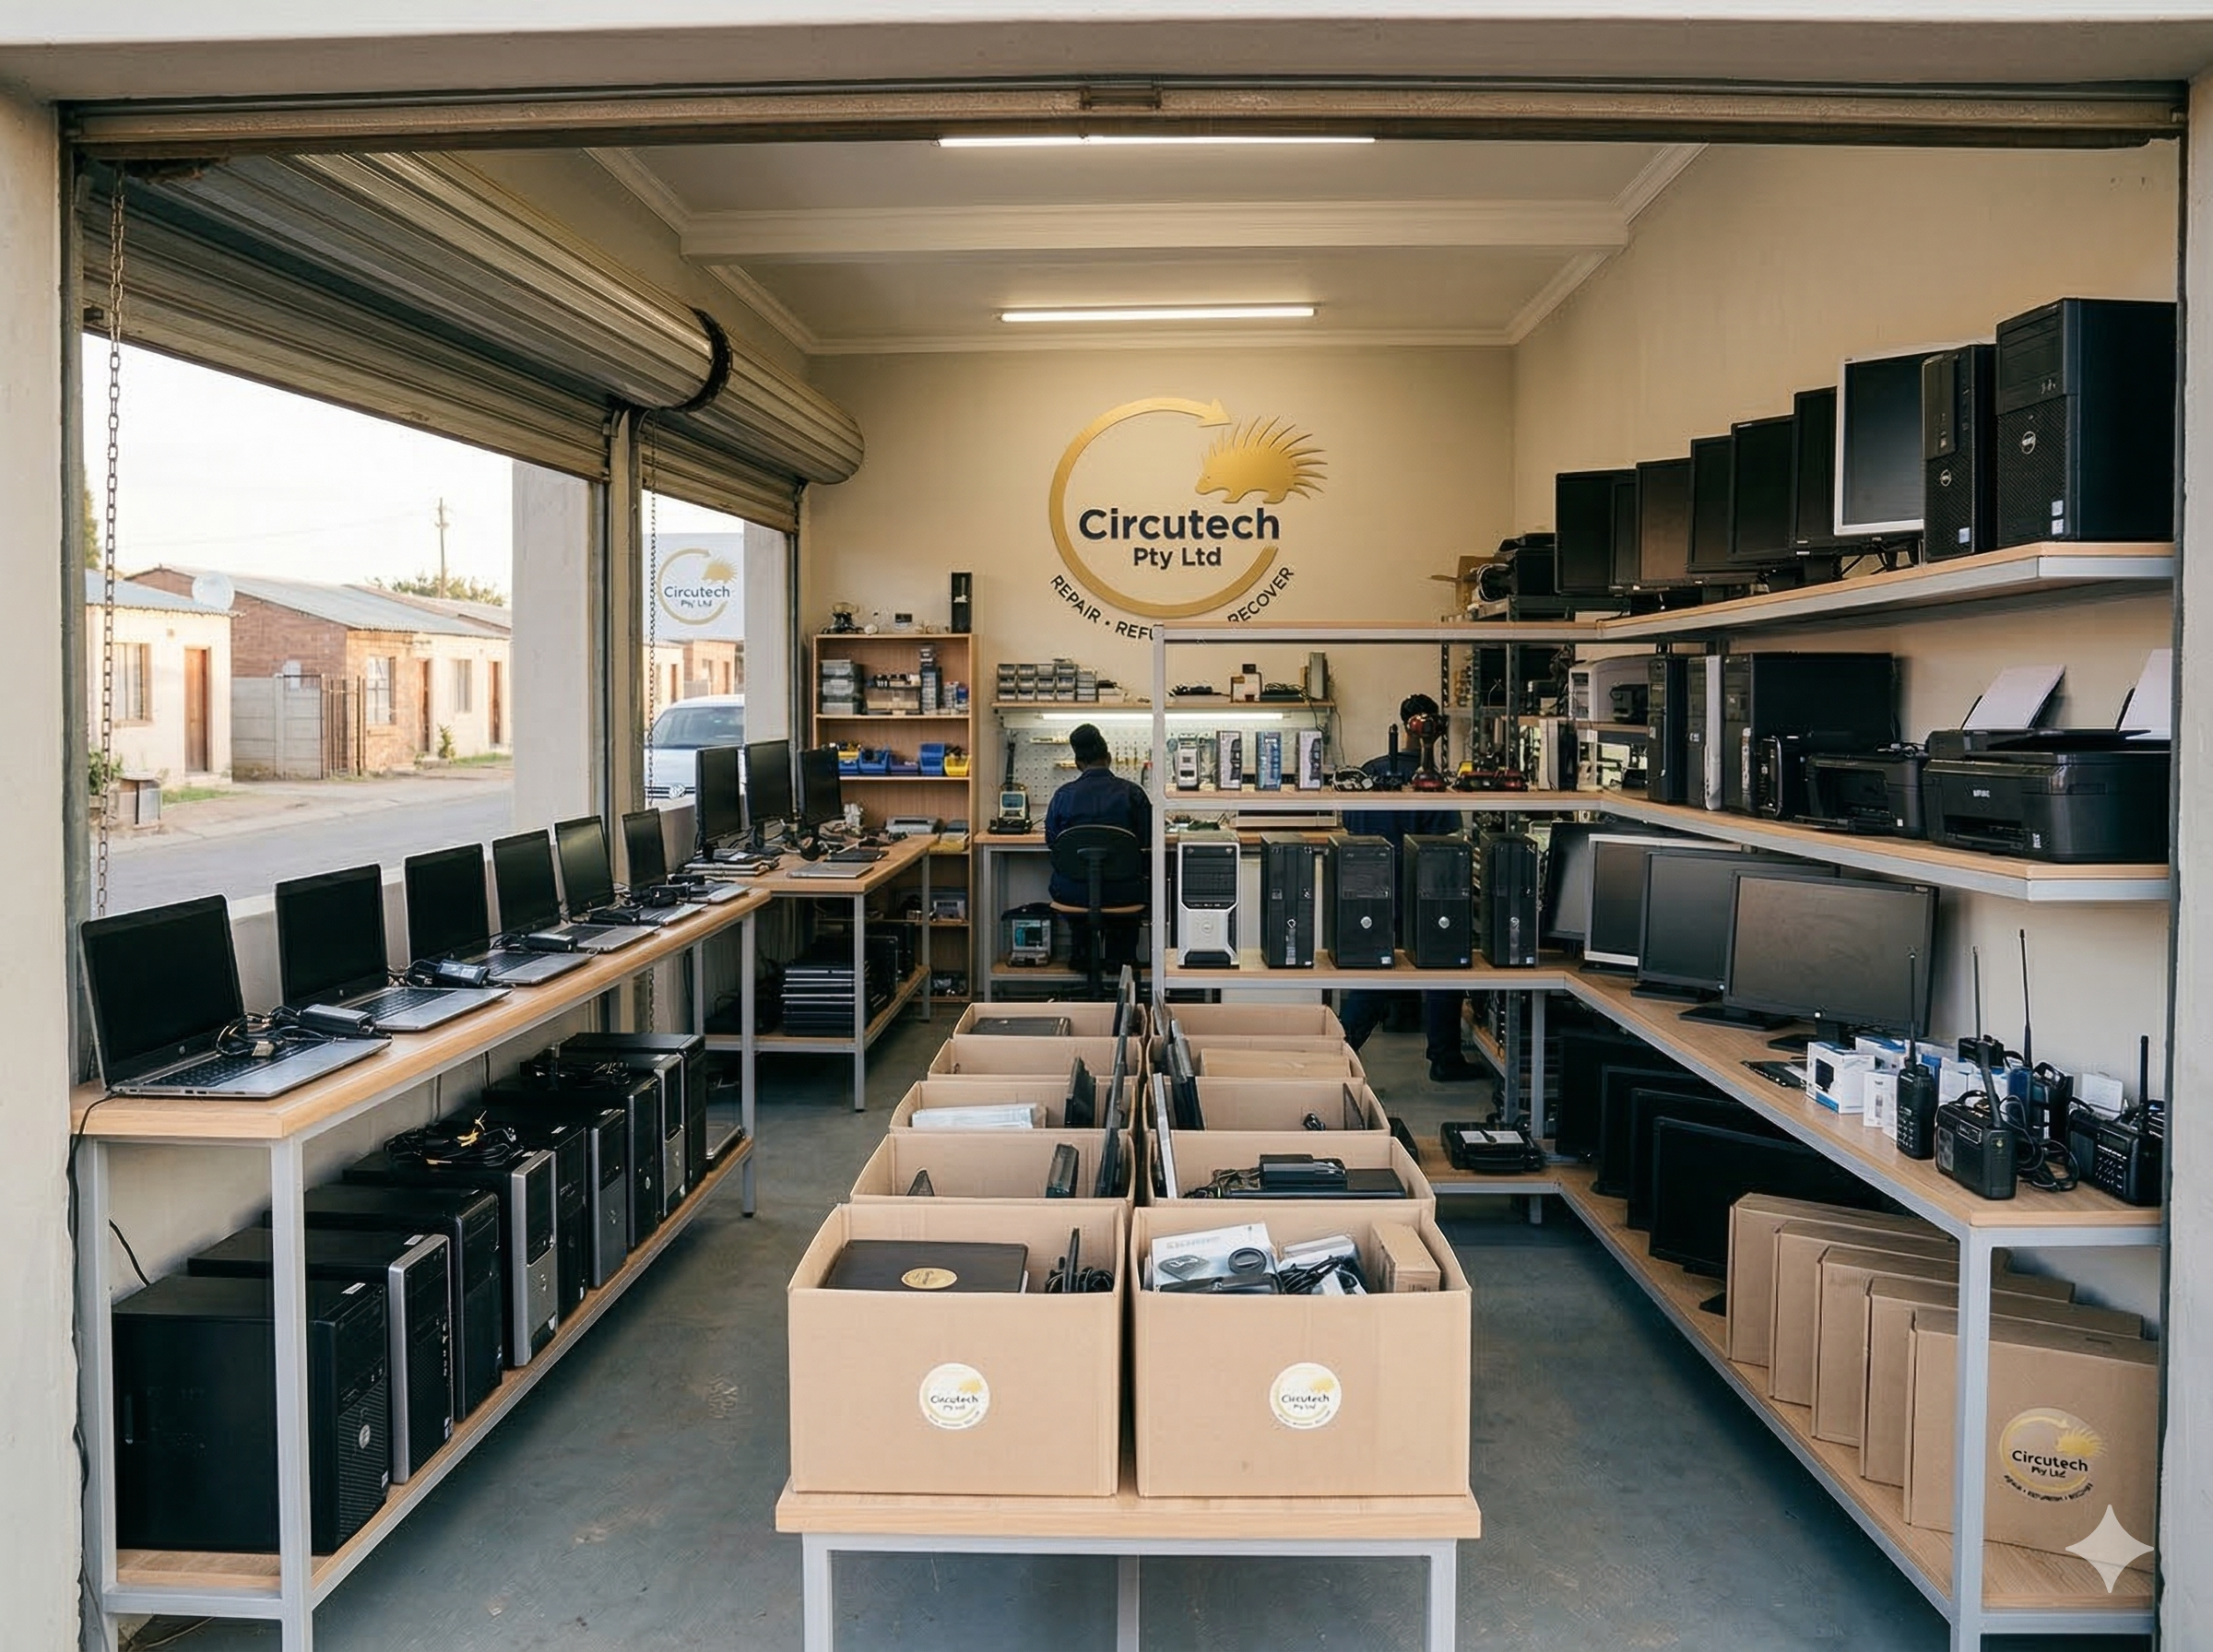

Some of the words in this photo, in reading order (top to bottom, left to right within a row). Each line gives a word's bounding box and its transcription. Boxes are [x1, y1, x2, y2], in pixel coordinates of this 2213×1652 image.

[1079, 508, 1280, 540] Circutech
[1133, 547, 1173, 570] Pty
[1182, 547, 1222, 566] Ltd
[664, 585, 730, 597] Circutech
[1050, 574, 1102, 624] REPAIR
[2012, 1450, 2089, 1472] Circutech
